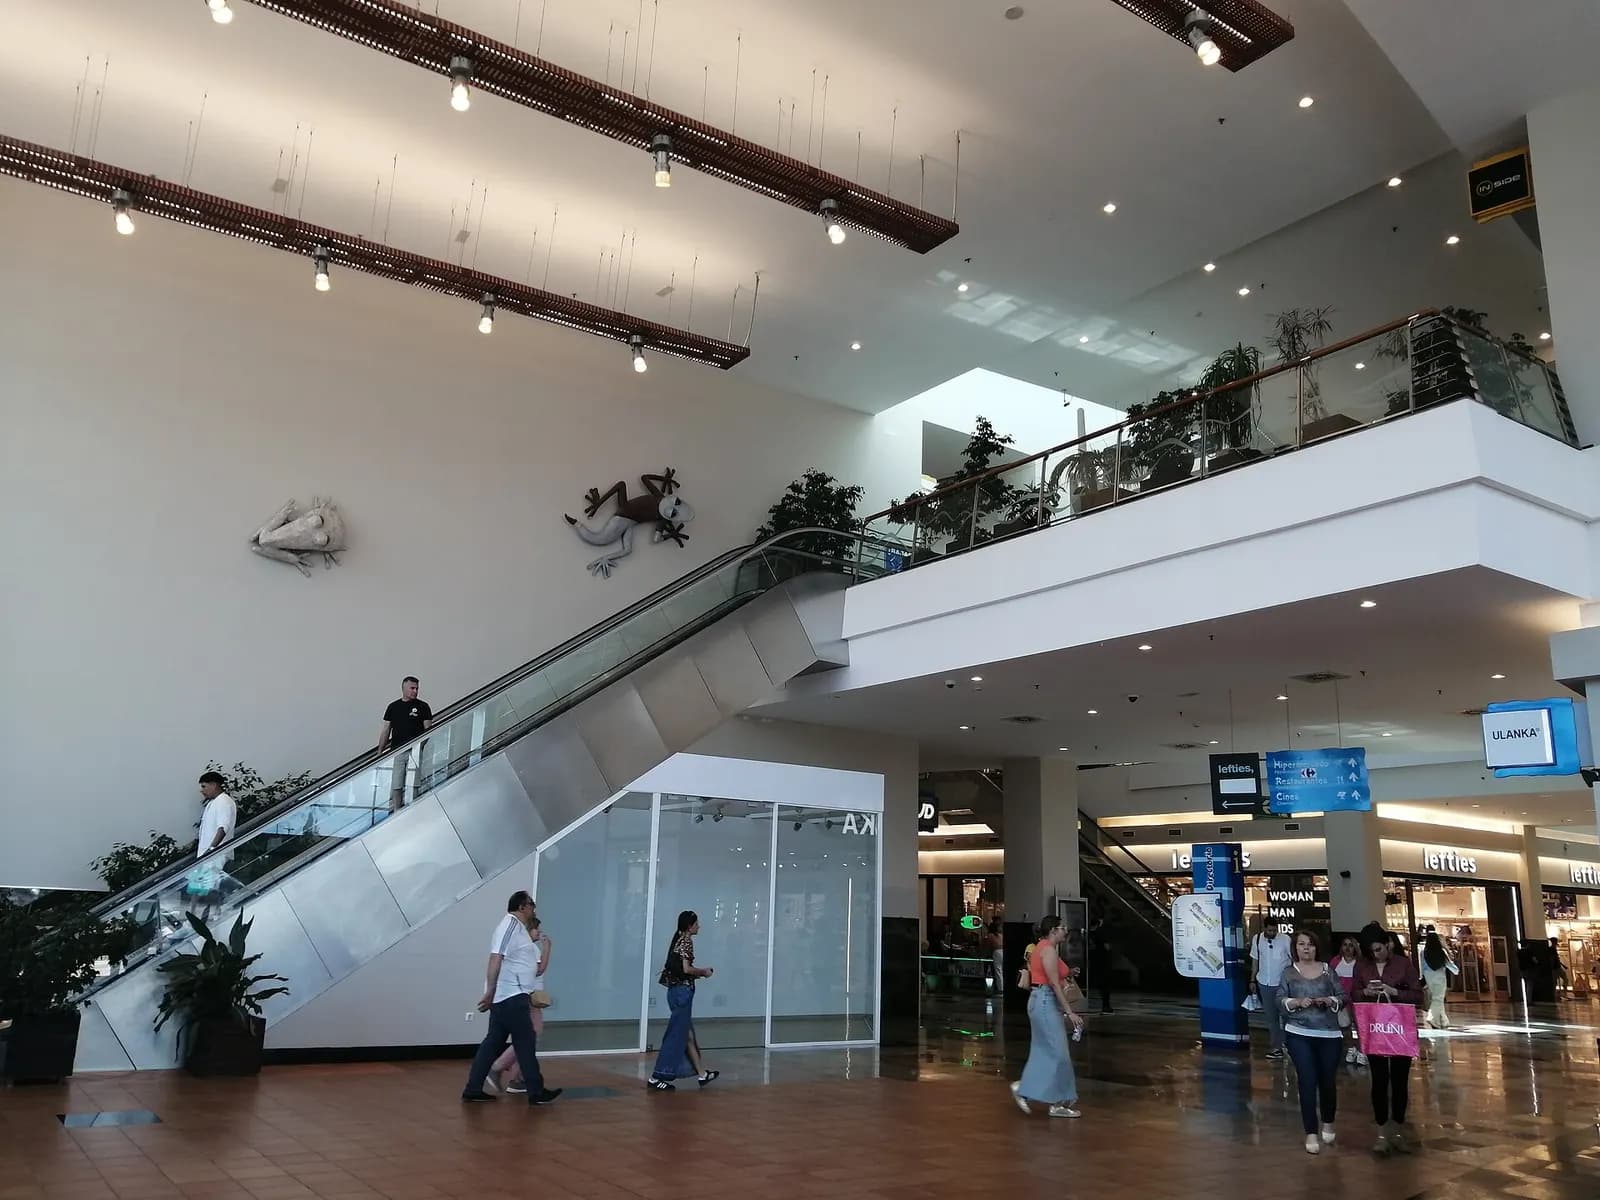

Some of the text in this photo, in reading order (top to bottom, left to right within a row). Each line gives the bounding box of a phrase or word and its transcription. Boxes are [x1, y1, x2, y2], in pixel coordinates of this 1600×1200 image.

[1273, 760, 1329, 770] Hiperdo
[1423, 848, 1477, 873] lefties
[1269, 891, 1314, 902] WOMAN
[1270, 907, 1295, 918] MAN
[1277, 923, 1294, 934] IDS
[1369, 1022, 1404, 1035] DRUNI
